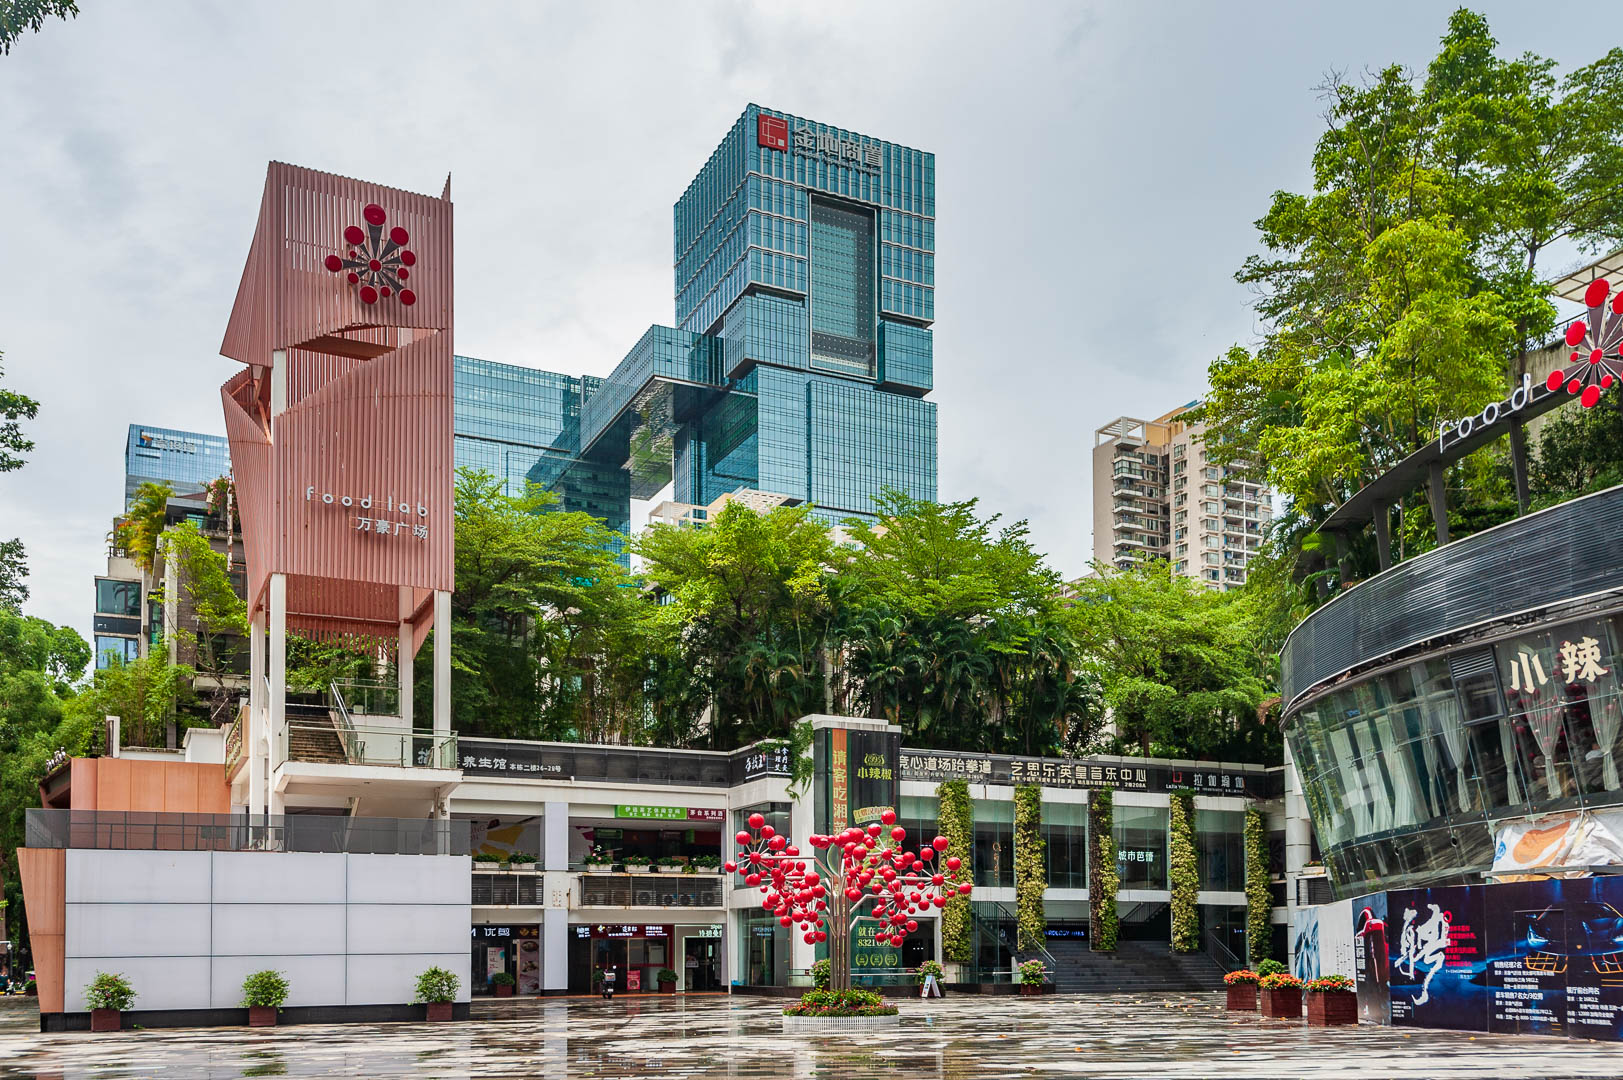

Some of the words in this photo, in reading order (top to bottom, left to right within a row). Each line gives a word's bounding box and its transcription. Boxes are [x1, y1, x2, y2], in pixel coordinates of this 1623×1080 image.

[1439, 372, 1531, 454] food
[306, 486, 372, 509] food
[387, 495, 428, 517] lab
[1510, 636, 1608, 694] 小辣
[462, 755, 507, 770] 养生馆
[857, 766, 892, 780] 小辣椒
[832, 750, 847, 836] 请客吃湘菜
[1118, 850, 1154, 863] 城市芭蕾
[1394, 903, 1451, 1005] 聘
